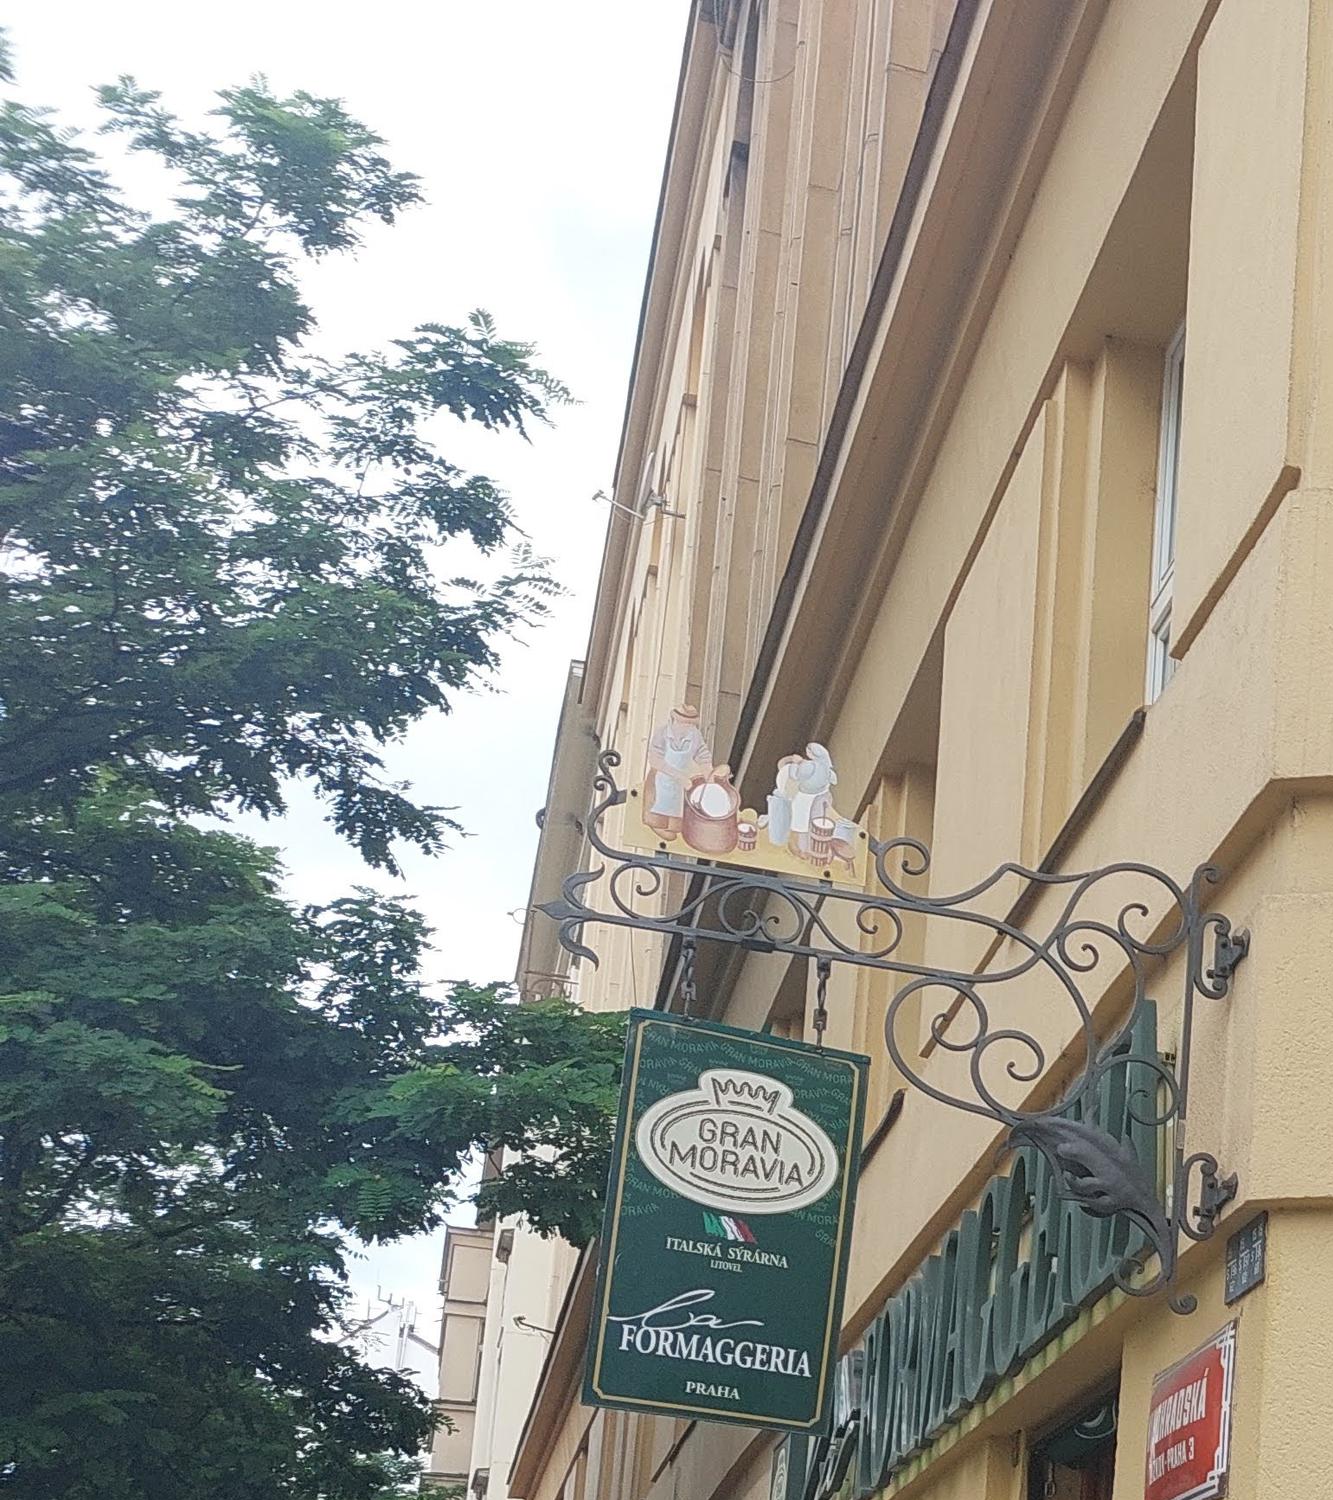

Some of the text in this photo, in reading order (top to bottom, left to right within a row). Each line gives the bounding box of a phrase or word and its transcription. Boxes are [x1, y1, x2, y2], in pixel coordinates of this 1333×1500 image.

[699, 1118, 782, 1158] GRAN
[668, 1140, 804, 1189] MORAVIA
[665, 1235, 790, 1270] ITALSKÁ SÝRÁRNA
[710, 1258, 743, 1273] LITOVEL
[618, 1324, 813, 1379] FORMAGGERIA
[684, 1380, 742, 1401] PRAHA
